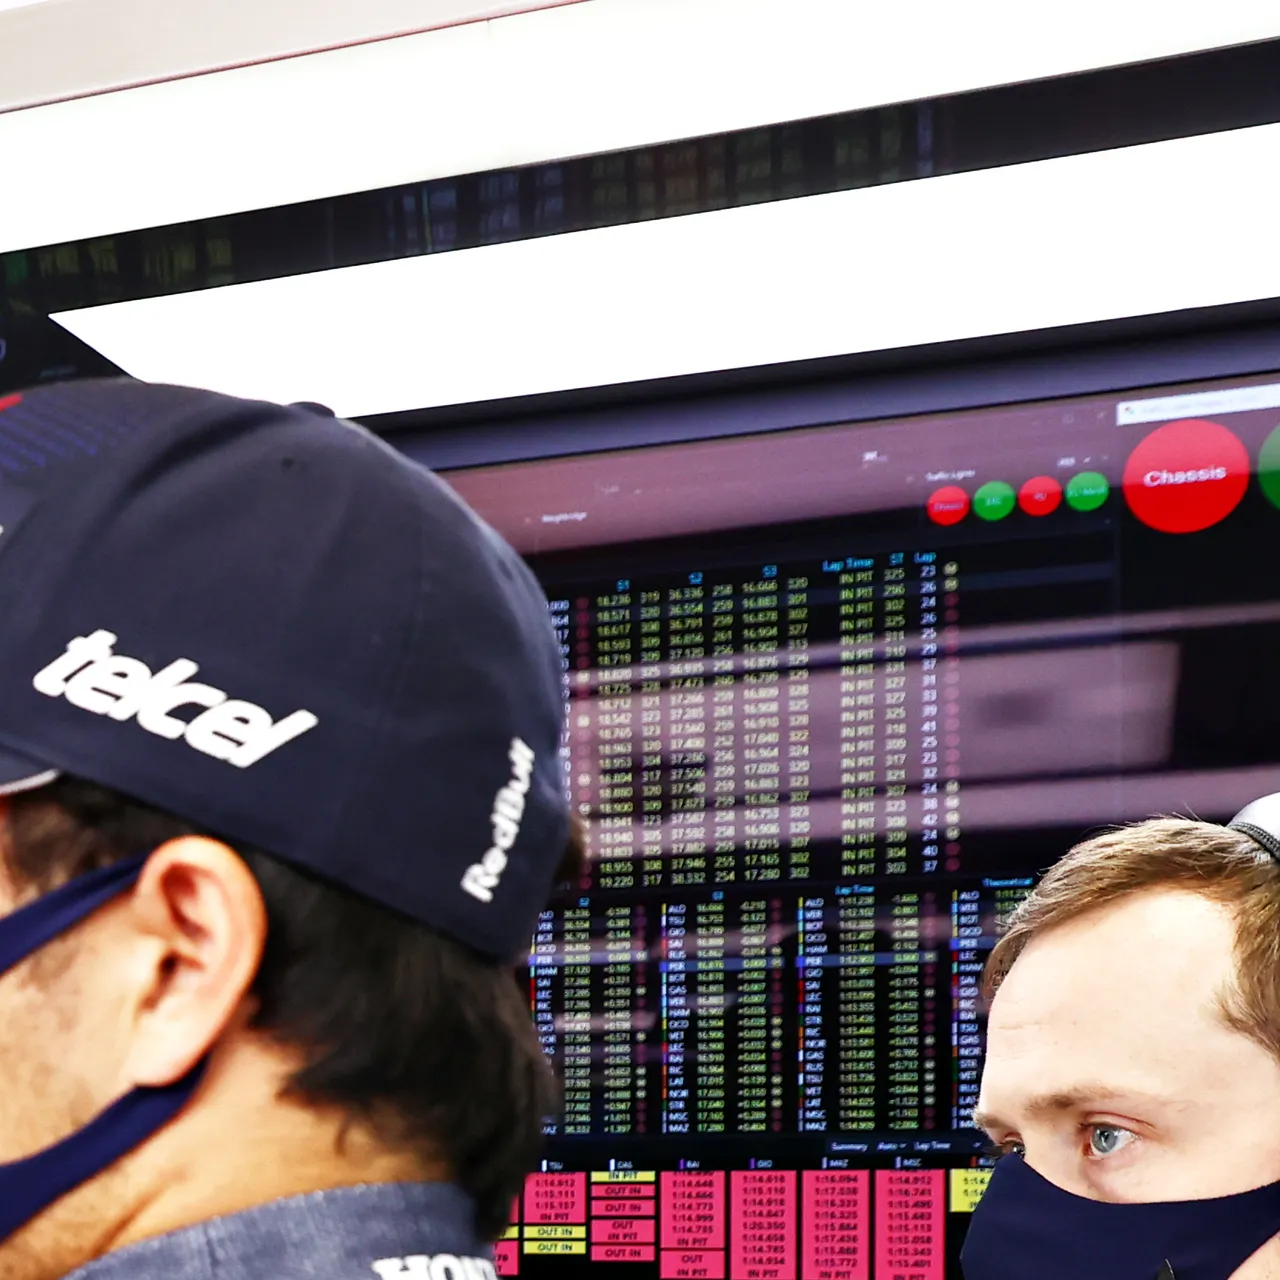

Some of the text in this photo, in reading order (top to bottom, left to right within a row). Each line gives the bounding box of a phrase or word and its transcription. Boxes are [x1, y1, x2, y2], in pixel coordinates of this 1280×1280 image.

[1143, 464, 1228, 488] Chassis
[822, 560, 844, 573] Lap
[846, 557, 874, 570] Time
[914, 552, 937, 564] Lap
[839, 573, 853, 584] IN
[855, 571, 873, 583] PIT
[920, 565, 936, 577] 23
[839, 588, 853, 600] IN
[855, 586, 873, 598] PIT
[839, 604, 853, 615] IN
[855, 602, 873, 614] PIT
[921, 596, 936, 608] 24
[840, 619, 854, 631] IN
[856, 617, 873, 629] PIT
[840, 635, 854, 646] IN
[856, 633, 873, 645] PIT
[840, 681, 854, 692] IN
[856, 679, 874, 691] PIT
[32, 628, 319, 769] telcel
[840, 695, 874, 708] IN PIT
[841, 712, 854, 723] IN
[856, 710, 874, 722] PIT
[841, 721, 937, 738] IN PIT 41
[841, 742, 855, 754] IN
[857, 741, 874, 753] PIT
[841, 783, 937, 800] IN PIT 24
[842, 830, 938, 845] IN PIT 24
[842, 849, 856, 860] IN
[858, 848, 875, 860] PIT
[842, 865, 856, 876] IN
[858, 864, 875, 875] PIT
[622, 1171, 638, 1179] PIT
[605, 1187, 641, 1195] OUT IN
[605, 1203, 641, 1212] OUT IN
[553, 1213, 569, 1221] PIT
[612, 1220, 633, 1229] OUT
[538, 1227, 572, 1236] OUT IN
[608, 1233, 638, 1241] IN PIT
[538, 1243, 572, 1252] OUT IN
[677, 1237, 707, 1246] IN PIT
[605, 1248, 641, 1257] OUT IN
[681, 1255, 702, 1263] OUT
[692, 1269, 707, 1277] PIT
